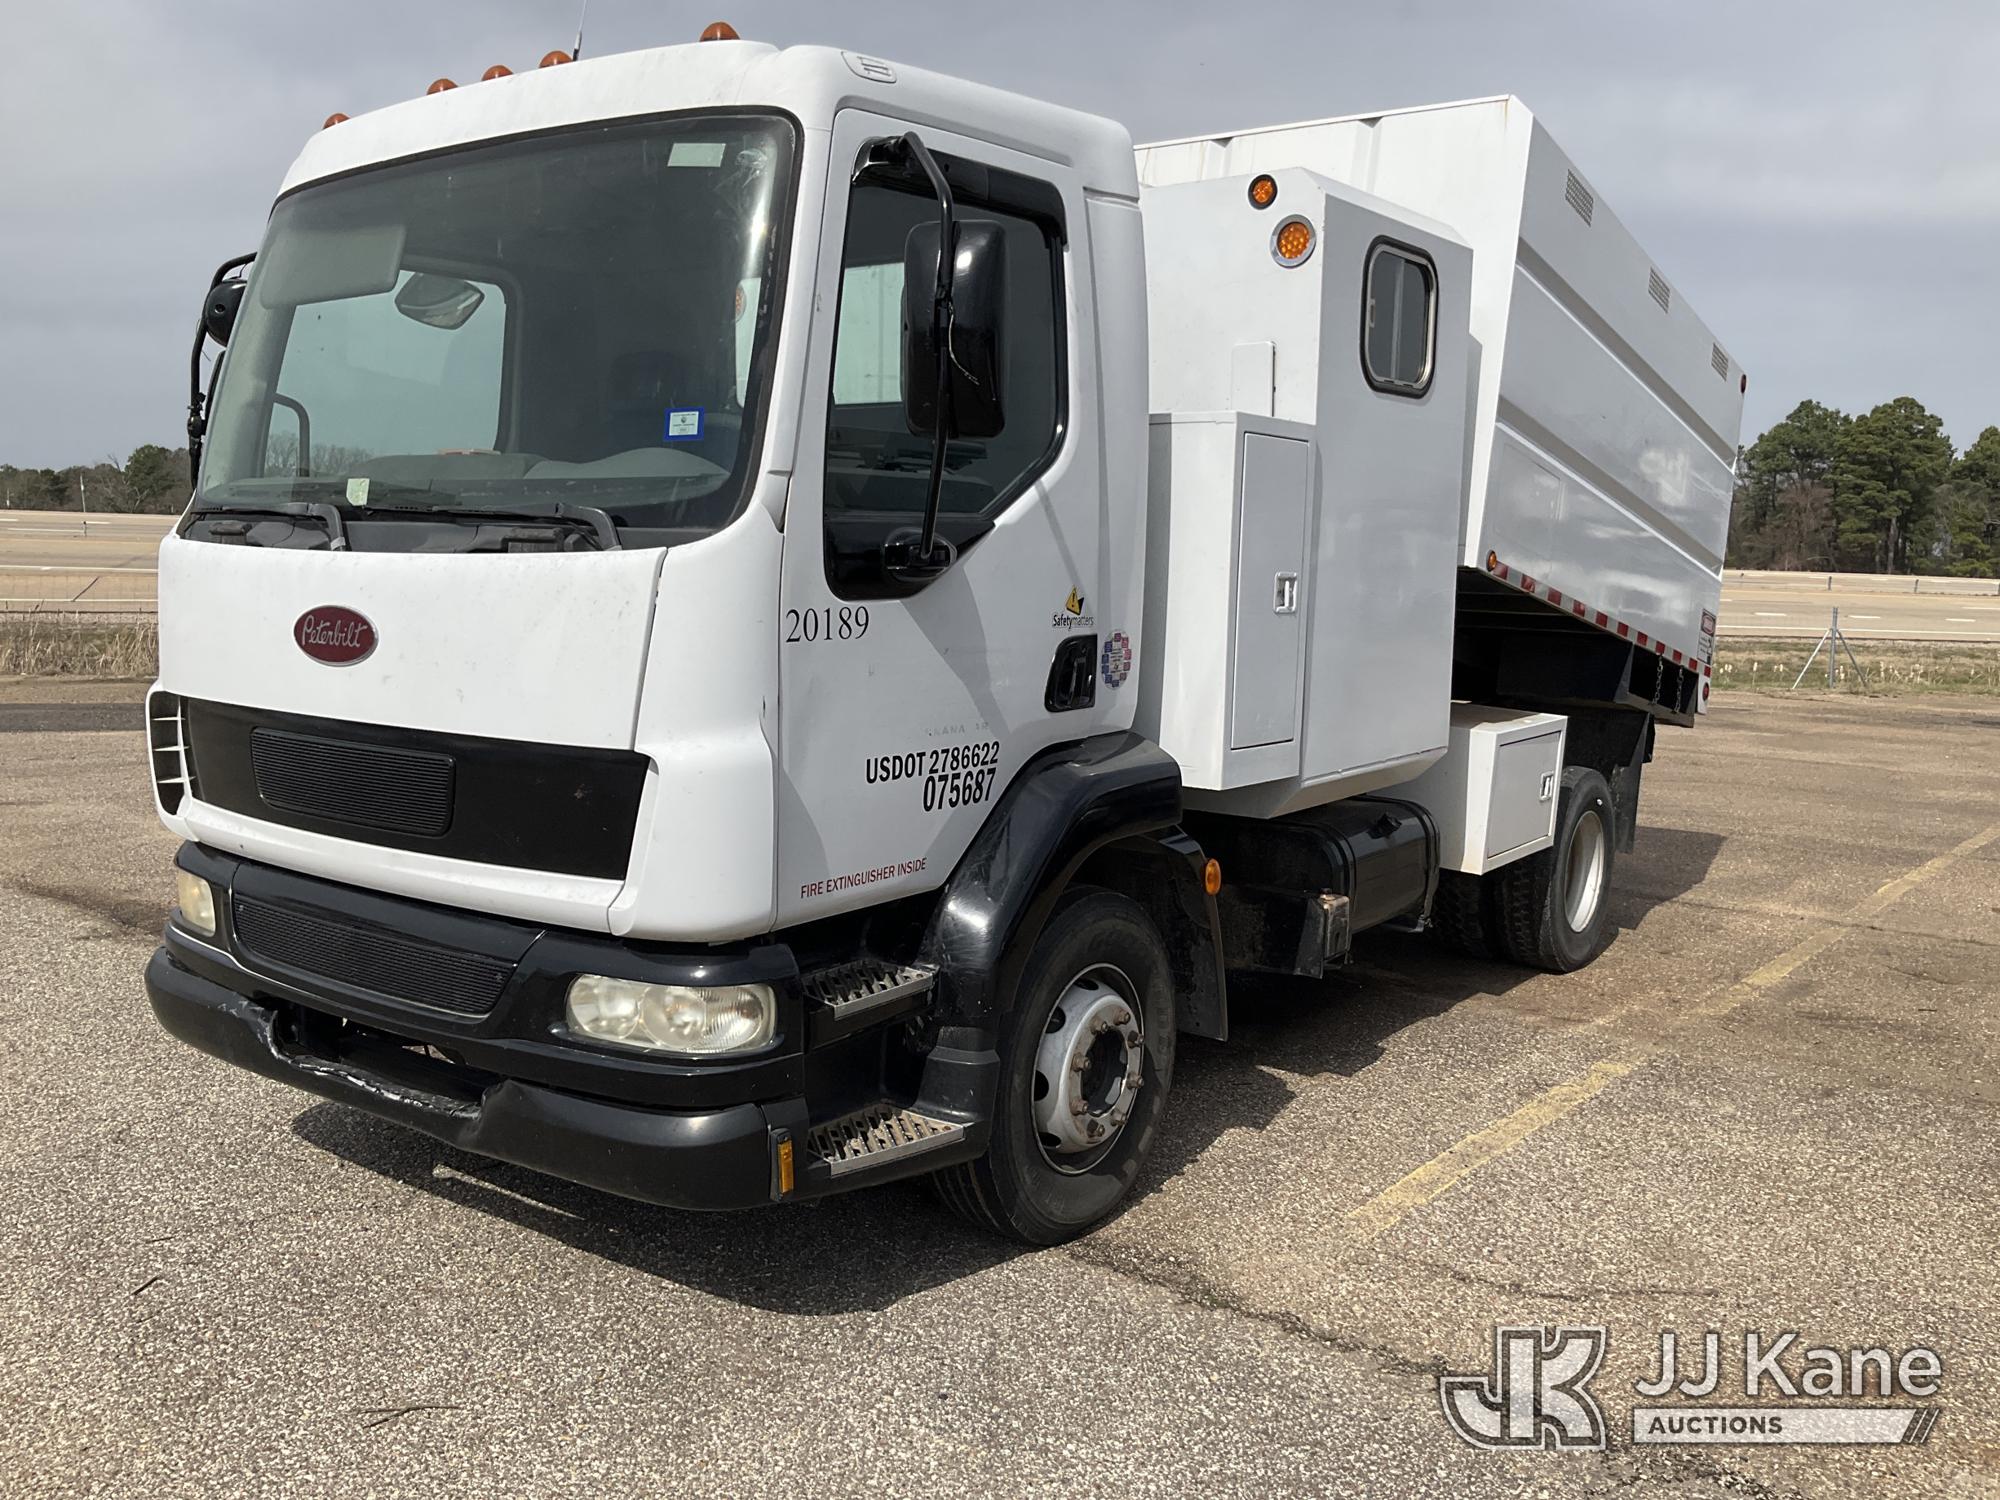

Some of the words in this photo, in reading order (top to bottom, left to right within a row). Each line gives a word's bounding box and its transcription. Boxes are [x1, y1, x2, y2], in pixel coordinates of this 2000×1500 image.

[302, 615, 367, 647] Peterbilt
[786, 606, 869, 643] 20189
[866, 751, 926, 784] USDOT
[928, 741, 1000, 774] 2786622
[923, 767, 997, 812] 075687
[800, 881, 824, 899] FIRE
[826, 865, 895, 893] EXTINGUISHER
[897, 857, 928, 876] INSIDE
